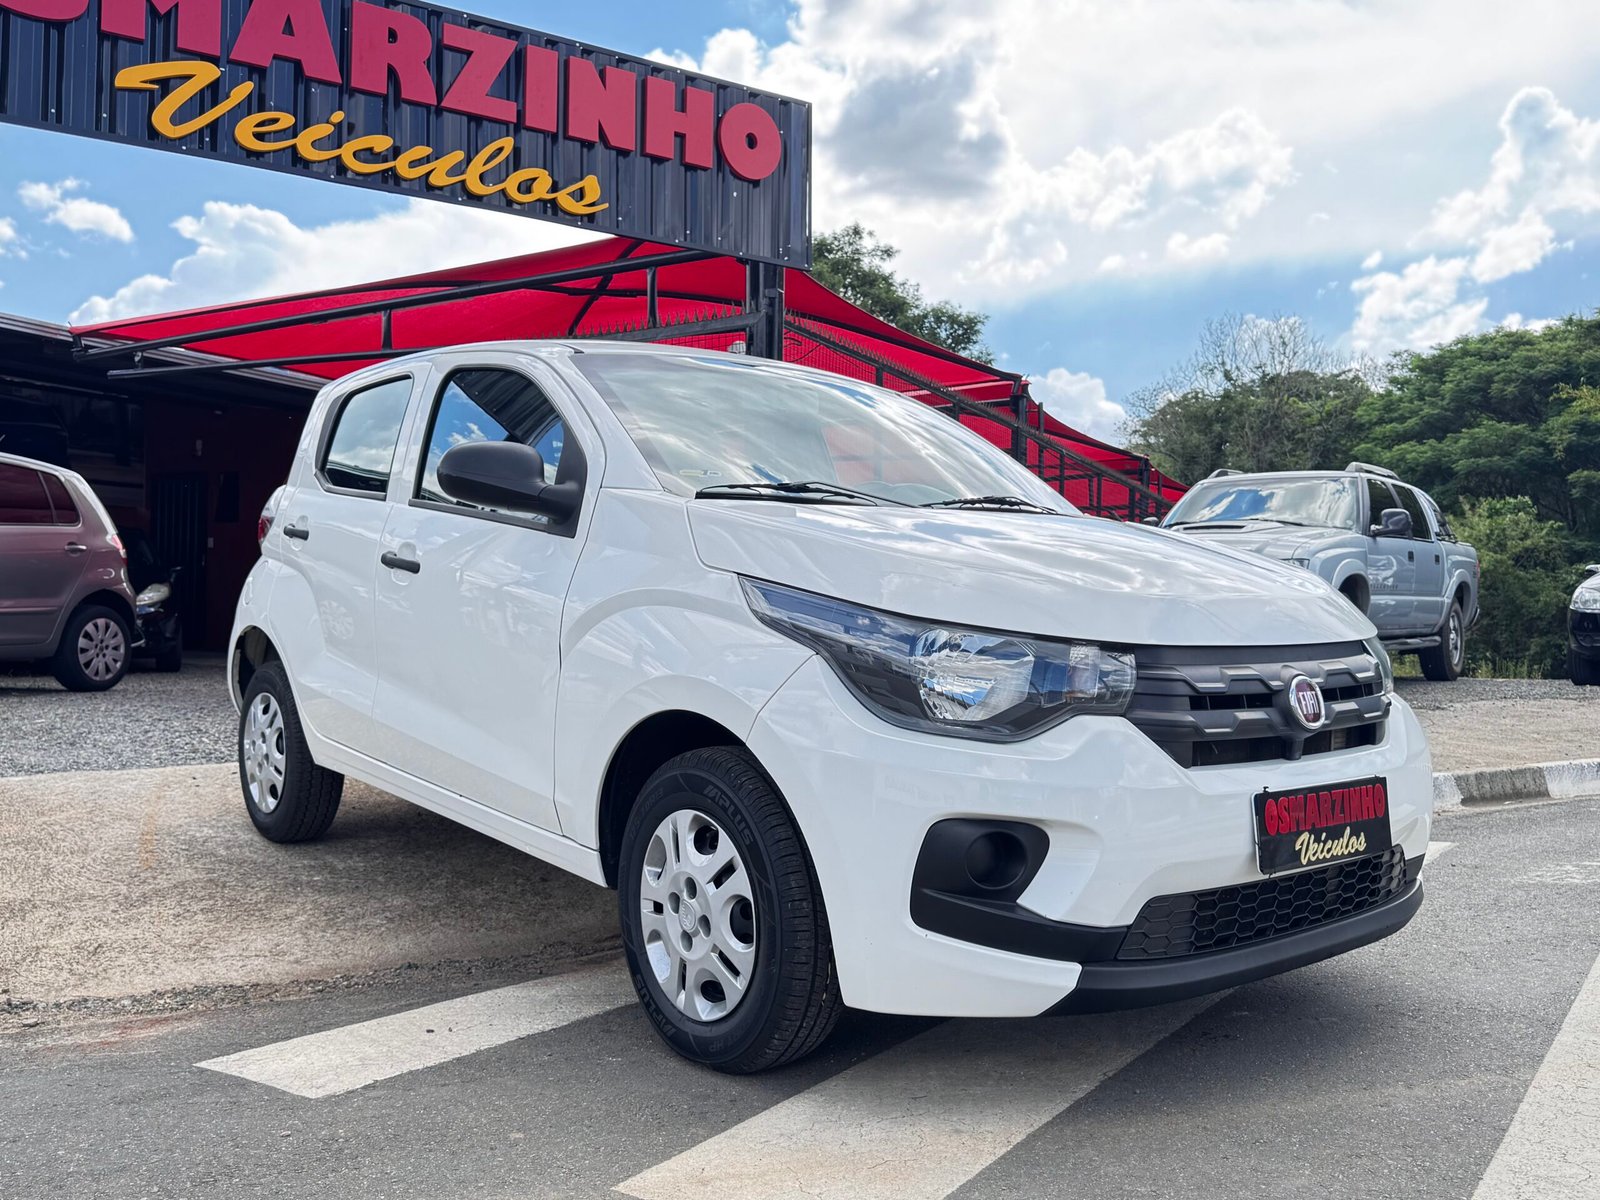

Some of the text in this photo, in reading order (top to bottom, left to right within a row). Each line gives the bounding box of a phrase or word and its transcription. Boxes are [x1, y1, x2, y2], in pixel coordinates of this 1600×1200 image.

[0, 0, 783, 181] ARZINHO
[1298, 691, 1320, 715] FIAT
[1264, 783, 1386, 837] OSMARZINHO
